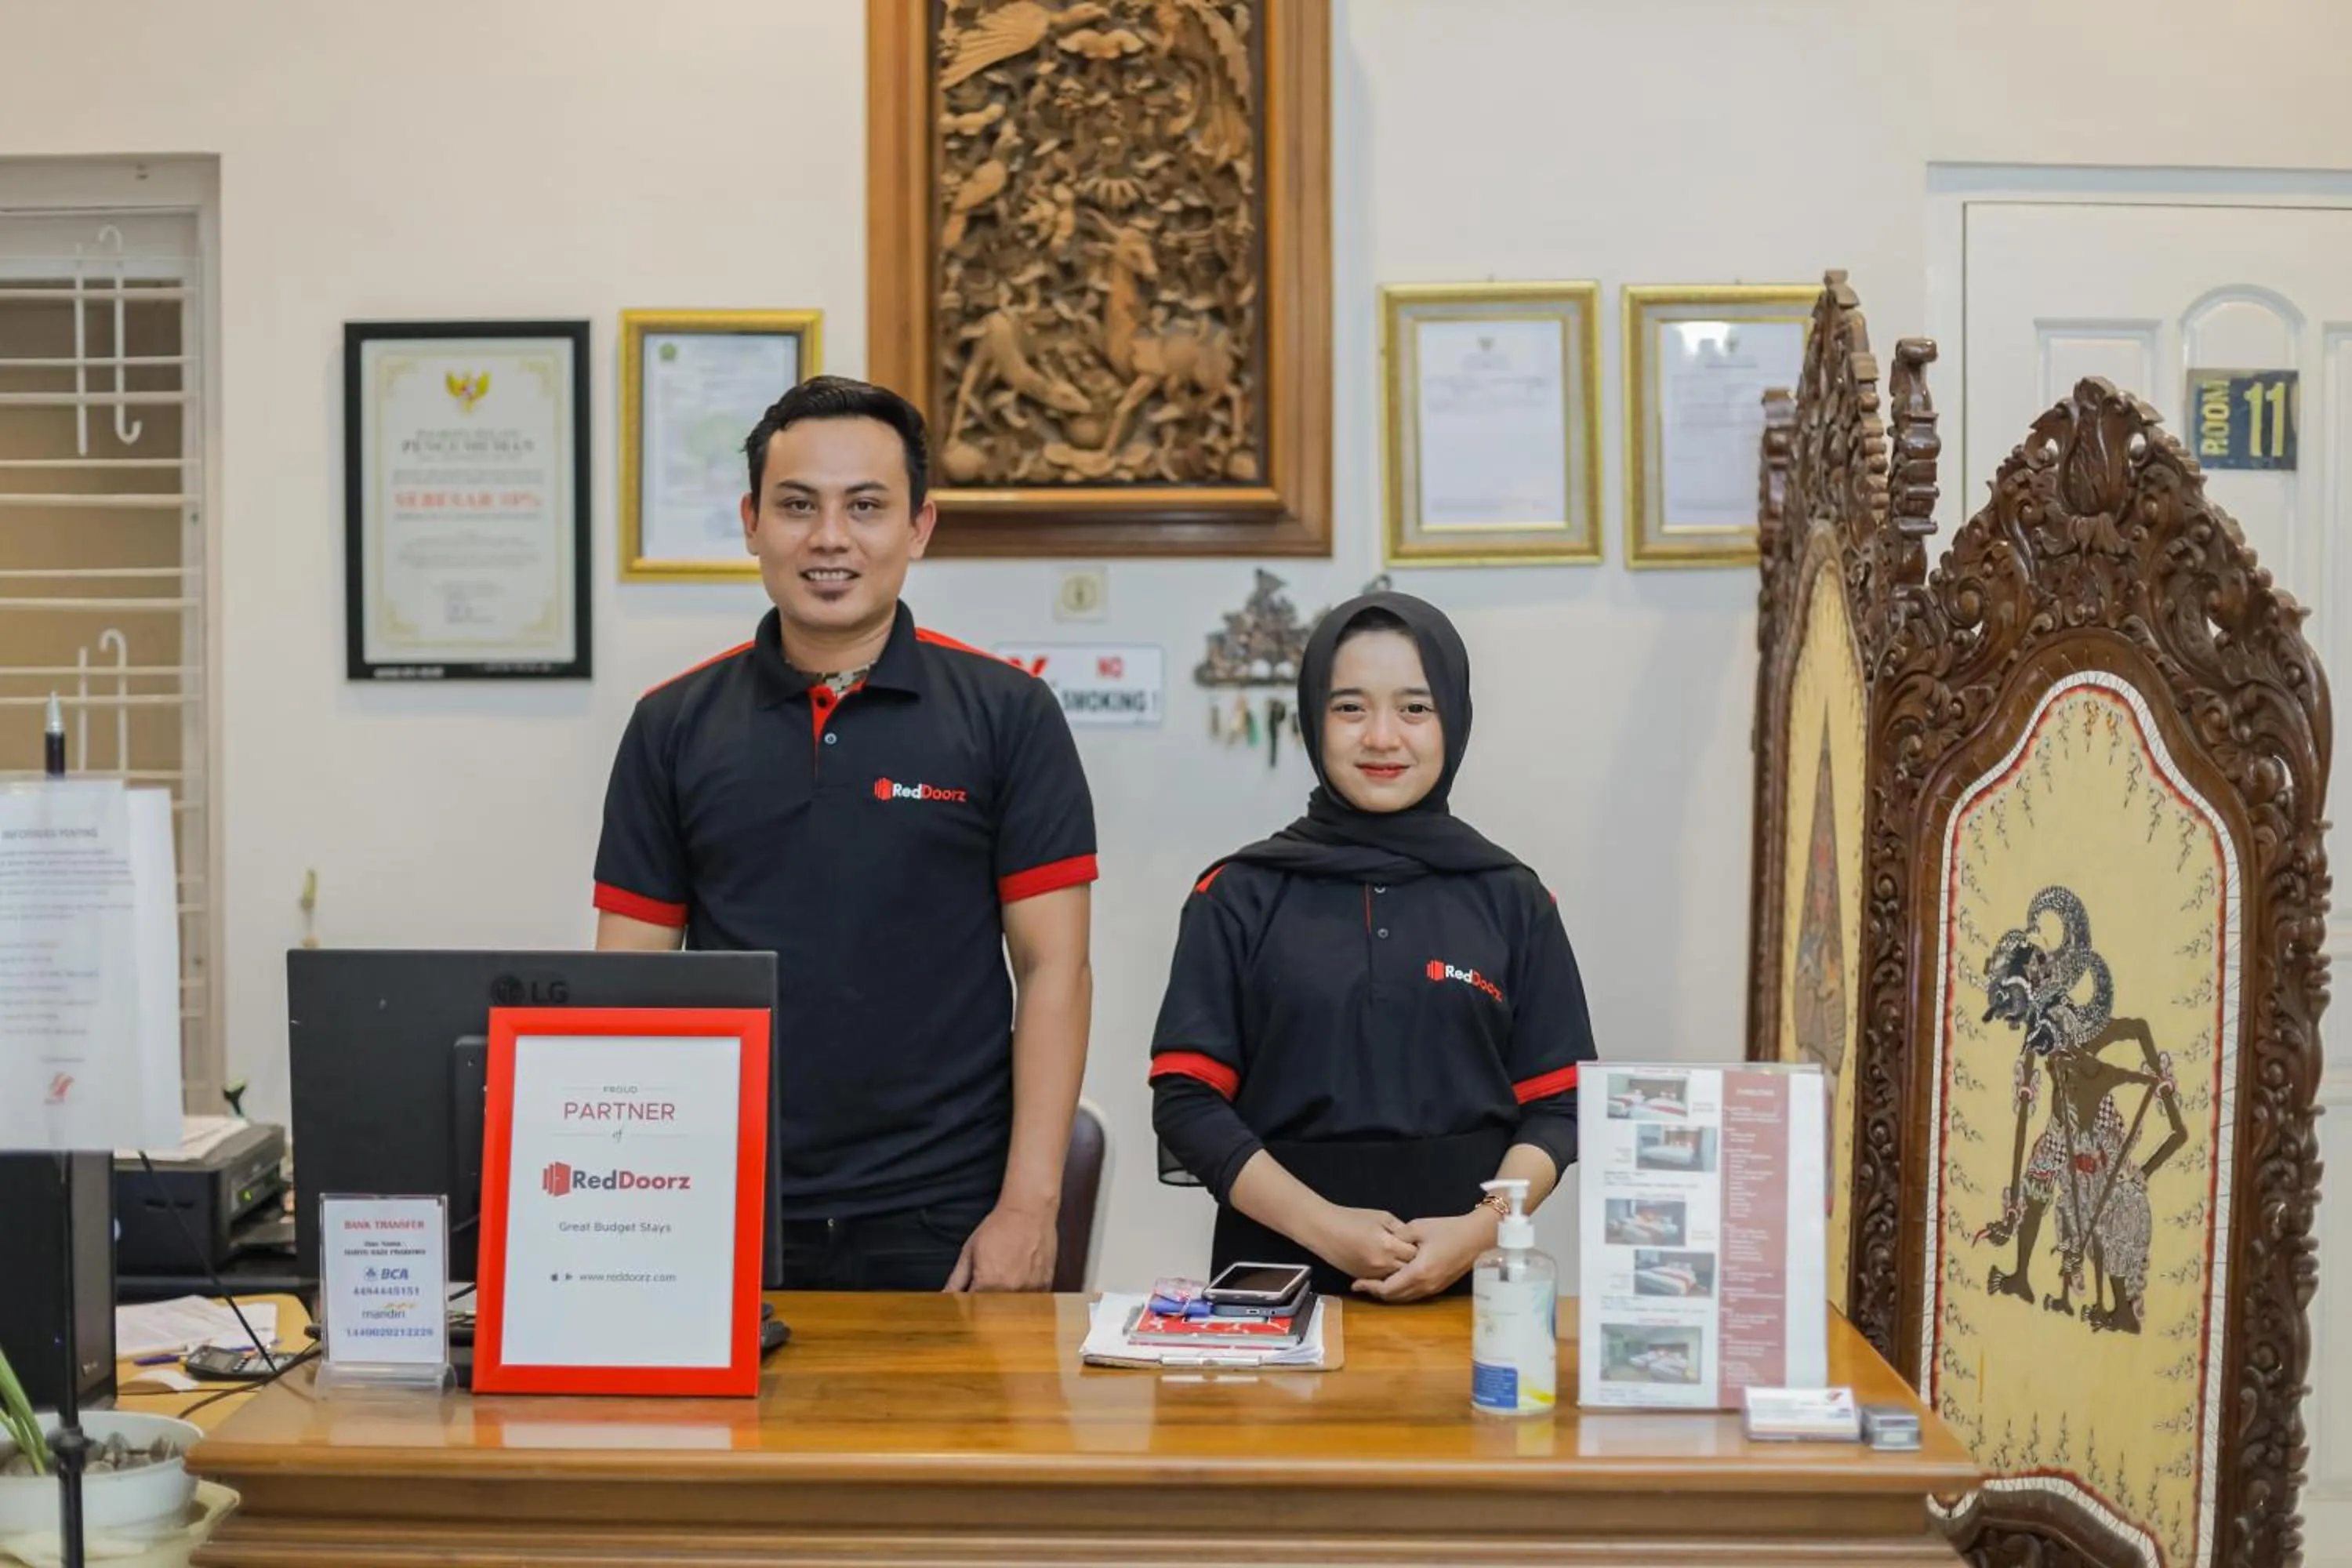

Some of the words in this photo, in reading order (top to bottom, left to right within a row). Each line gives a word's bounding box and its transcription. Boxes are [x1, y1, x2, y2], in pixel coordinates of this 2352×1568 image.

[2200, 379, 2230, 456] ROOM
[2243, 381, 2286, 458] 11
[892, 782, 967, 802] RedDoorz
[531, 980, 570, 1004] LG
[1445, 964, 1504, 1002] RedDoorz
[602, 1085, 639, 1094] PROUD
[563, 1102, 676, 1120] PARTNER
[572, 1168, 691, 1190] RedDoorz
[343, 1220, 371, 1229] BANK
[374, 1220, 425, 1229] TRANSFER
[559, 1221, 590, 1232] Great
[593, 1221, 636, 1234] Budget
[639, 1222, 672, 1234] Stays
[380, 1267, 409, 1280] BCA
[361, 1308, 406, 1319] mandiri
